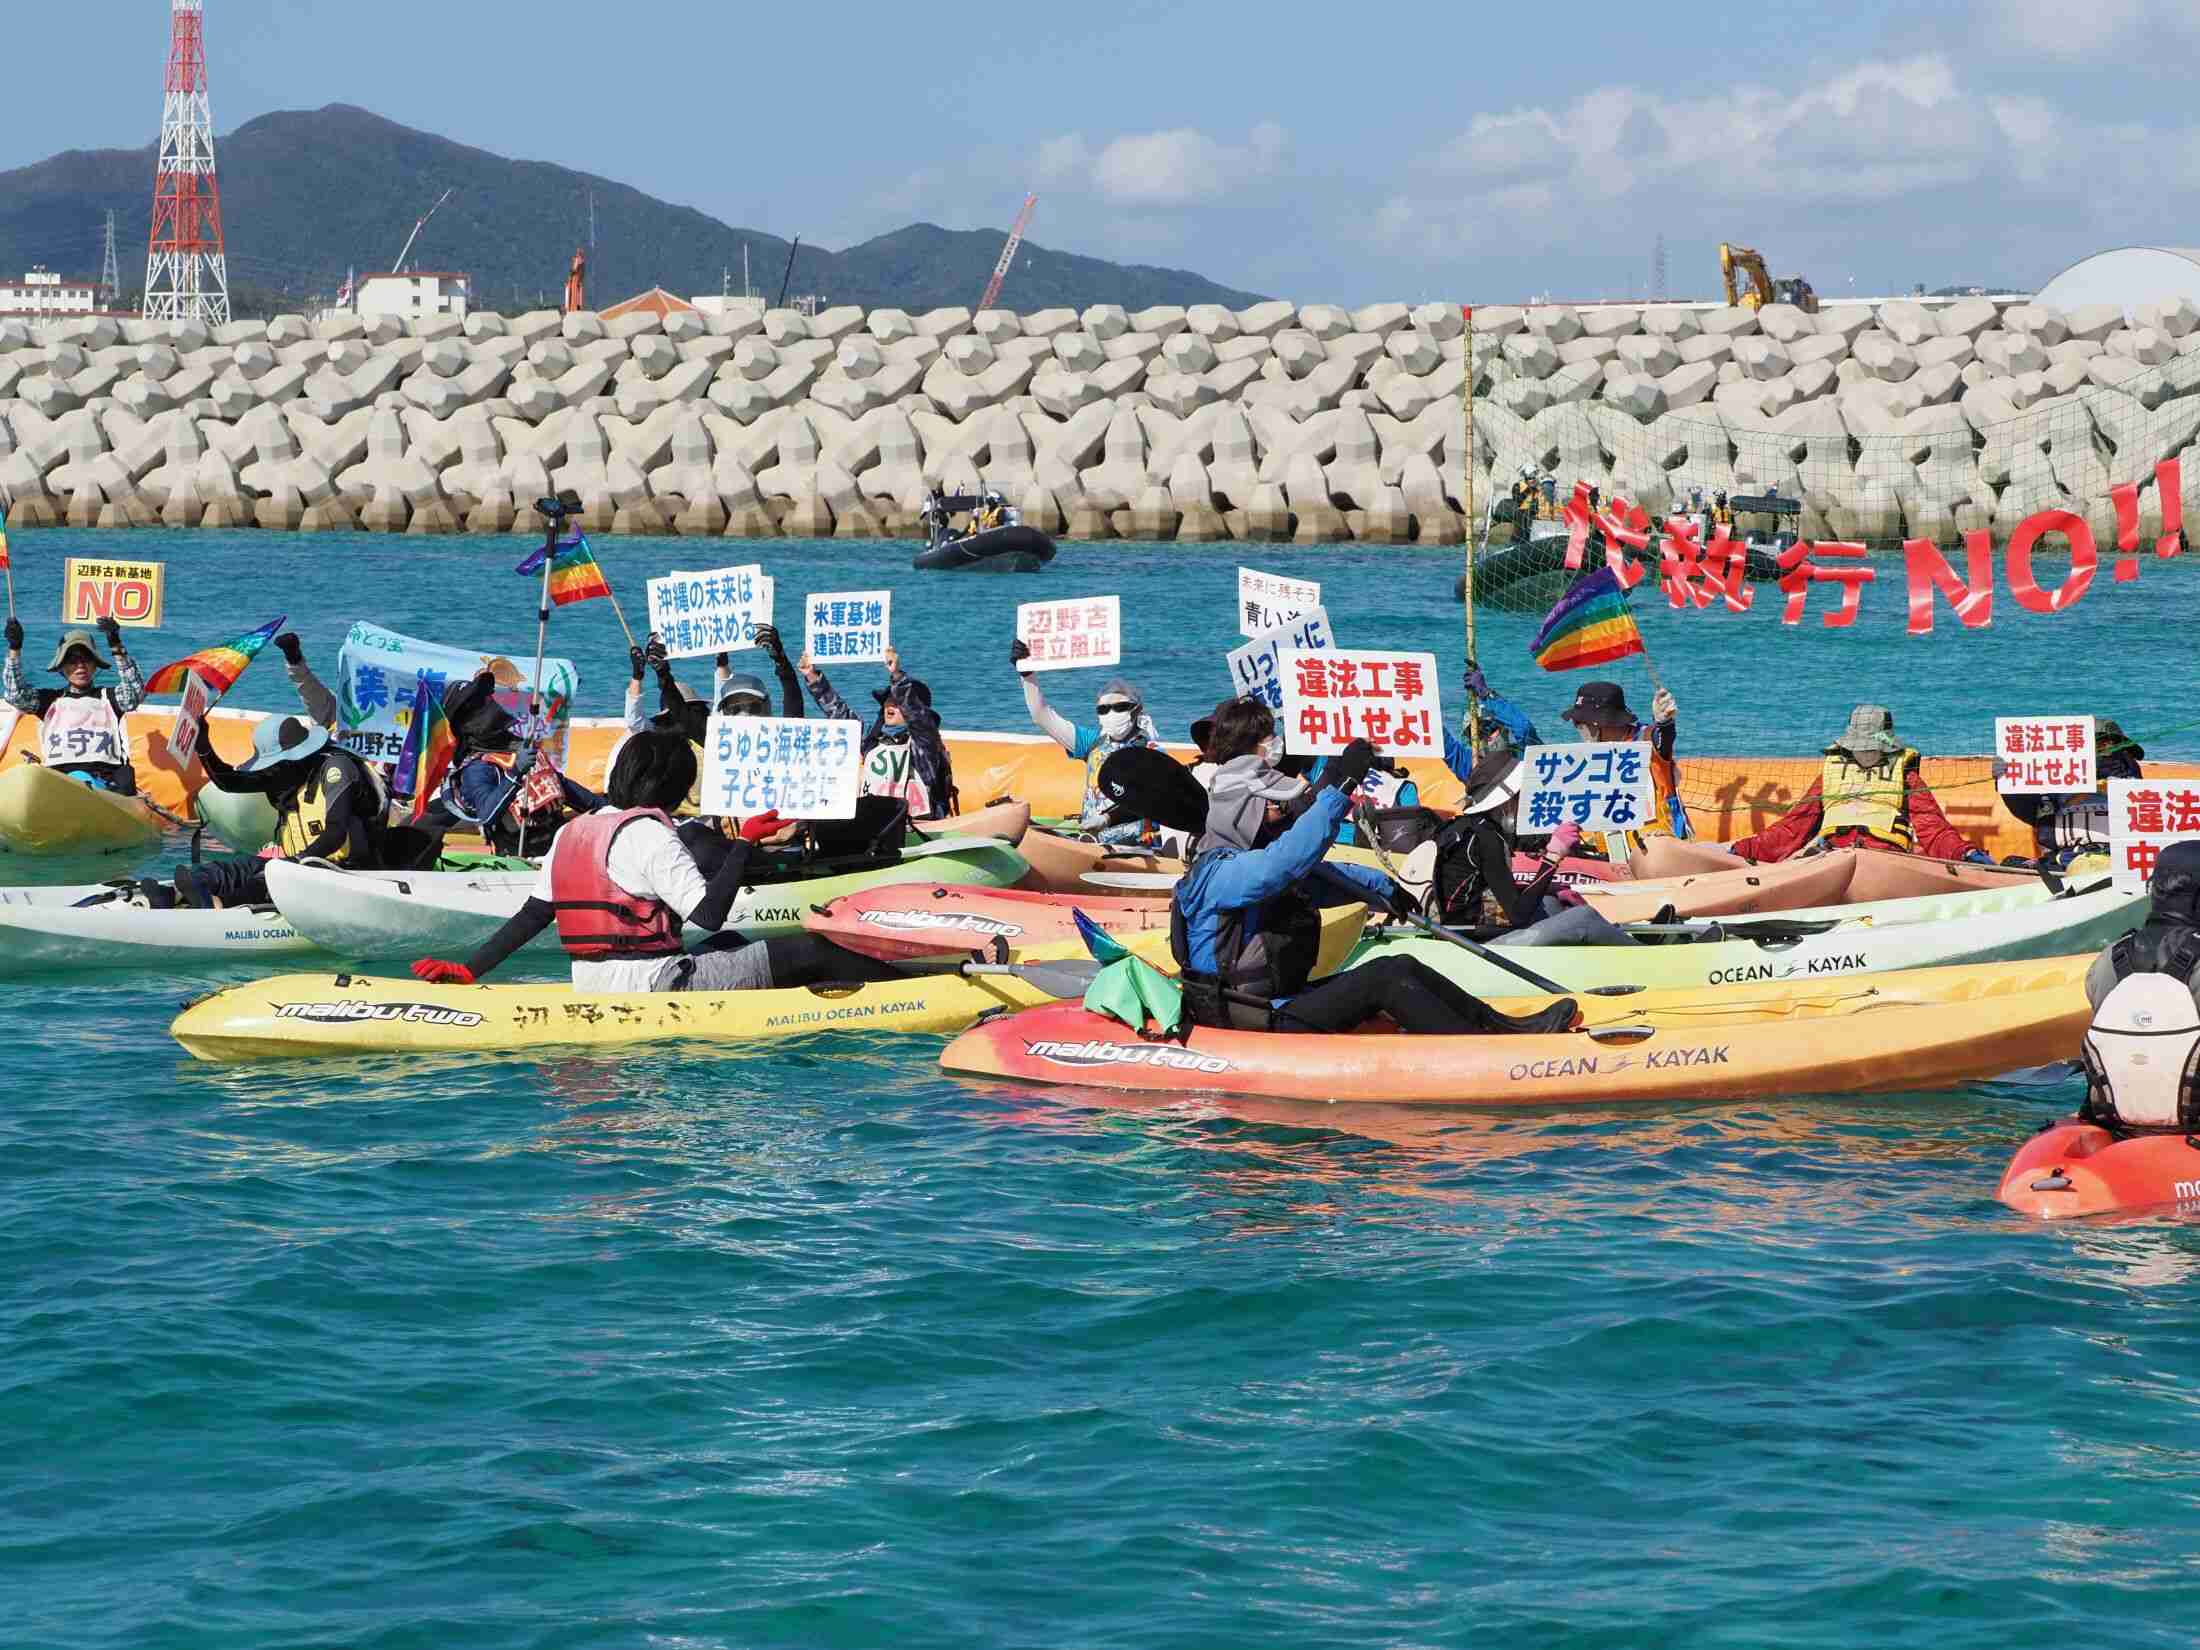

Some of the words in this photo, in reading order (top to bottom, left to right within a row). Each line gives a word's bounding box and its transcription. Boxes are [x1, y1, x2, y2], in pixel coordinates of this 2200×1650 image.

[77, 564, 153, 580] 辺野古新基地
[76, 580, 153, 620] NO
[657, 572, 752, 617] 沖縄の未来は
[1241, 575, 1316, 603] 未来に残そう
[813, 601, 882, 628] 米軍基地
[1026, 606, 1108, 634] 辺野古
[660, 611, 756, 652] 沖縄が決める
[813, 630, 881, 658] 建設反対!
[1295, 656, 1424, 701] 違法工事
[1299, 703, 1432, 747] 中止せよ!
[2004, 723, 2086, 754] 違法工事
[717, 722, 849, 766] ちゅら海残そう
[1534, 748, 1642, 786] サンゴを
[2004, 758, 2088, 787] 中止せよ!
[1527, 788, 1637, 827] 殺すな
[754, 907, 801, 922] KAYAK
[859, 908, 953, 929] malibu
[952, 916, 1024, 938] two
[224, 929, 261, 941] MALIBU
[262, 928, 295, 940] OCEAN
[1708, 963, 1774, 986] OCEAN
[1808, 952, 1867, 974] KAYAK
[275, 1000, 402, 1021] malibu
[400, 1003, 485, 1027] two
[766, 1010, 822, 1028] MALIBU
[825, 1005, 876, 1021] OCEAN
[880, 999, 927, 1015] KAYAK
[1025, 1039, 1150, 1066] malibu
[1146, 1047, 1232, 1074] two
[1509, 1056, 1598, 1082] OCEAN
[1645, 1043, 1730, 1069] KAYAK
